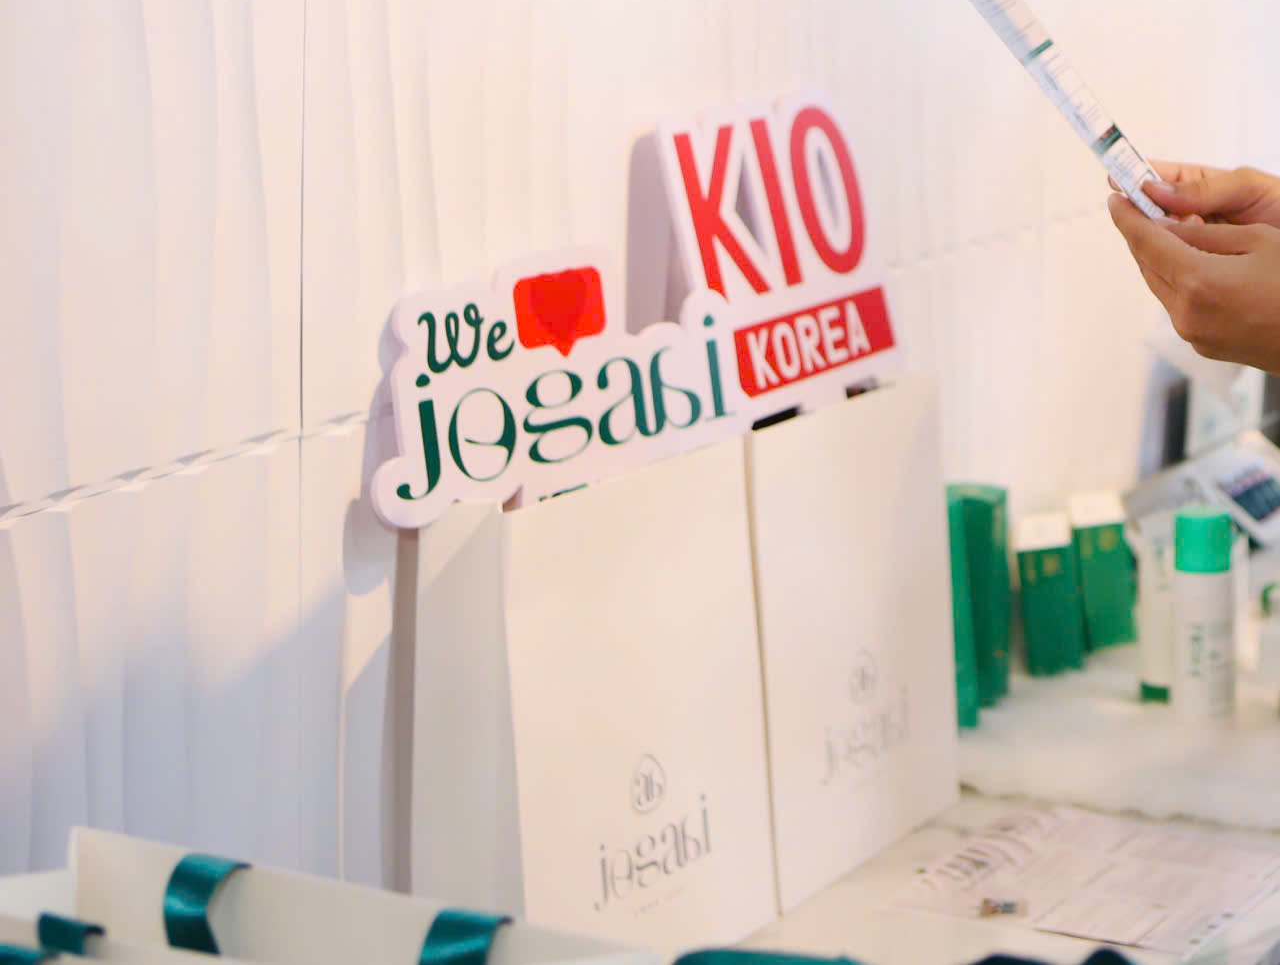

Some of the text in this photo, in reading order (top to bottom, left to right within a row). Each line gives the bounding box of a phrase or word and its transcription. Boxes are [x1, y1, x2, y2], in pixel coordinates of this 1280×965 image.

[673, 103, 866, 303] KIO
[417, 303, 515, 373] We
[746, 300, 871, 390] KOREA
